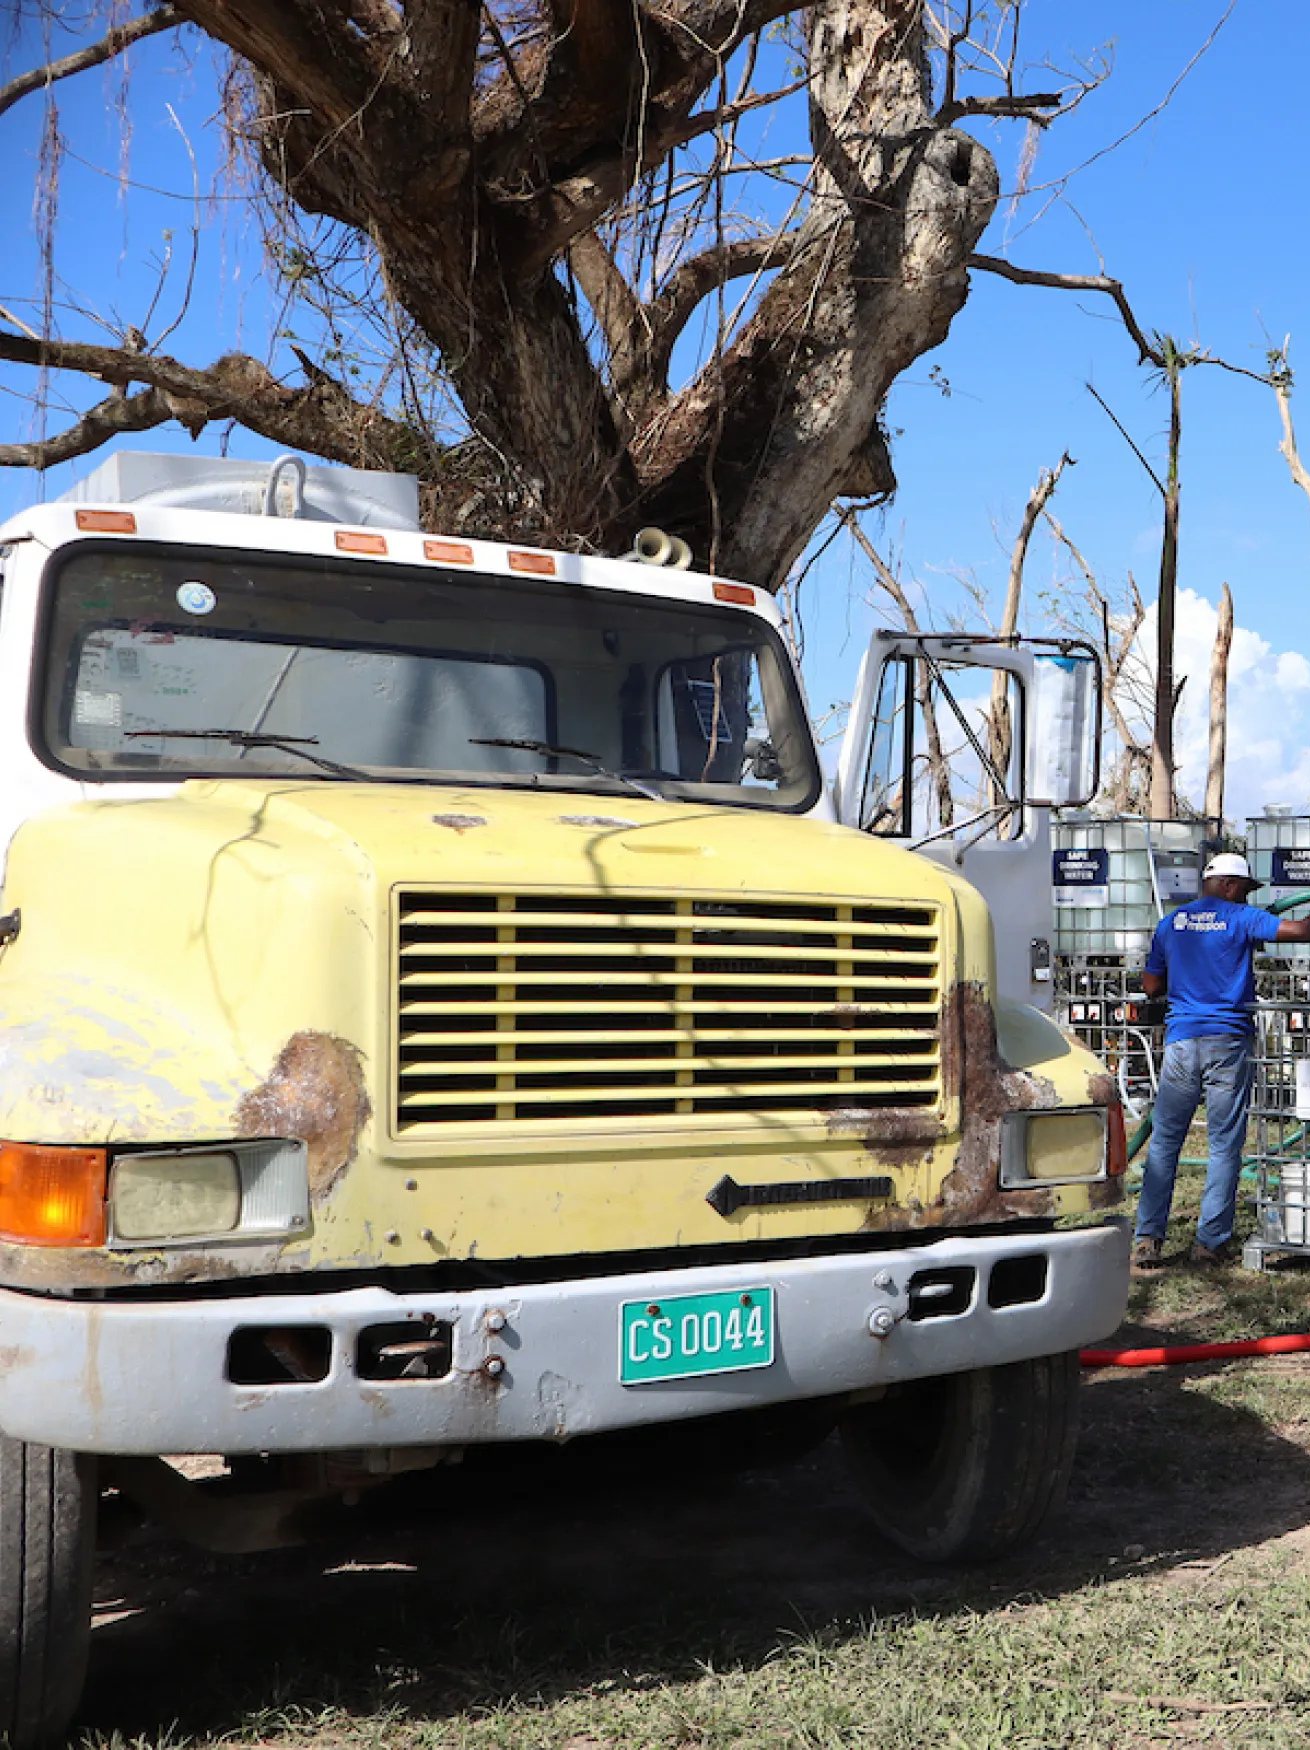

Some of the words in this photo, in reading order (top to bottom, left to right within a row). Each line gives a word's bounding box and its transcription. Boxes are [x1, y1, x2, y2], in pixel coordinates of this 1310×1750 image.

[1187, 921, 1226, 931] mission
[629, 1318, 672, 1362] CS
[682, 1305, 765, 1355] 0044
